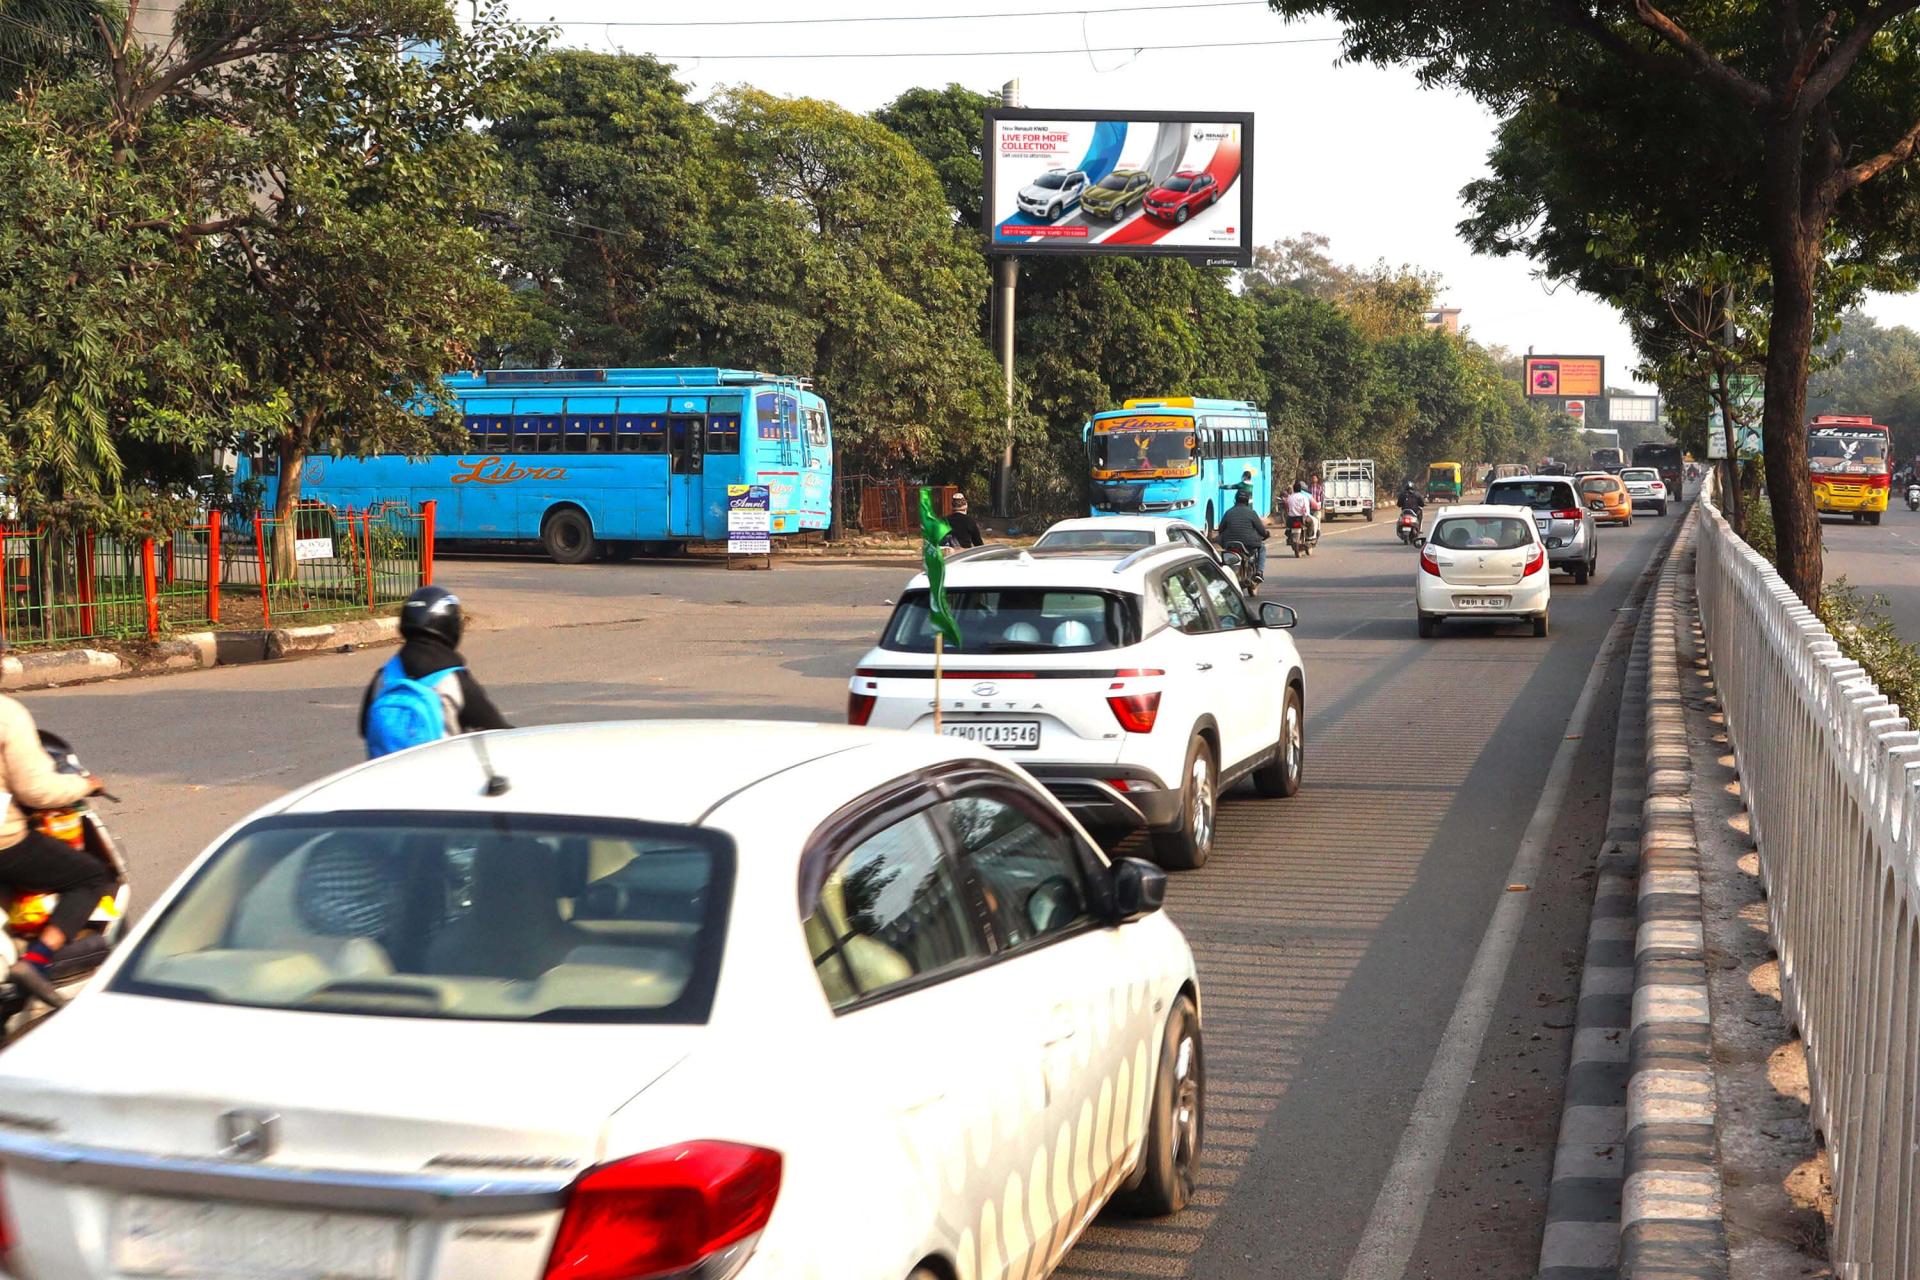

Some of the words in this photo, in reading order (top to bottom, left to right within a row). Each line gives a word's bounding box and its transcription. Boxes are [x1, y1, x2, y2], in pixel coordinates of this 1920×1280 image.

[1002, 134, 1021, 142] LIVE
[1023, 134, 1040, 142] FOR
[1042, 134, 1068, 143] MORE
[1002, 142, 1056, 151] COLLECTION
[1817, 428, 1878, 438] Kartar
[451, 456, 567, 484] Libra
[730, 497, 765, 508] Amrit
